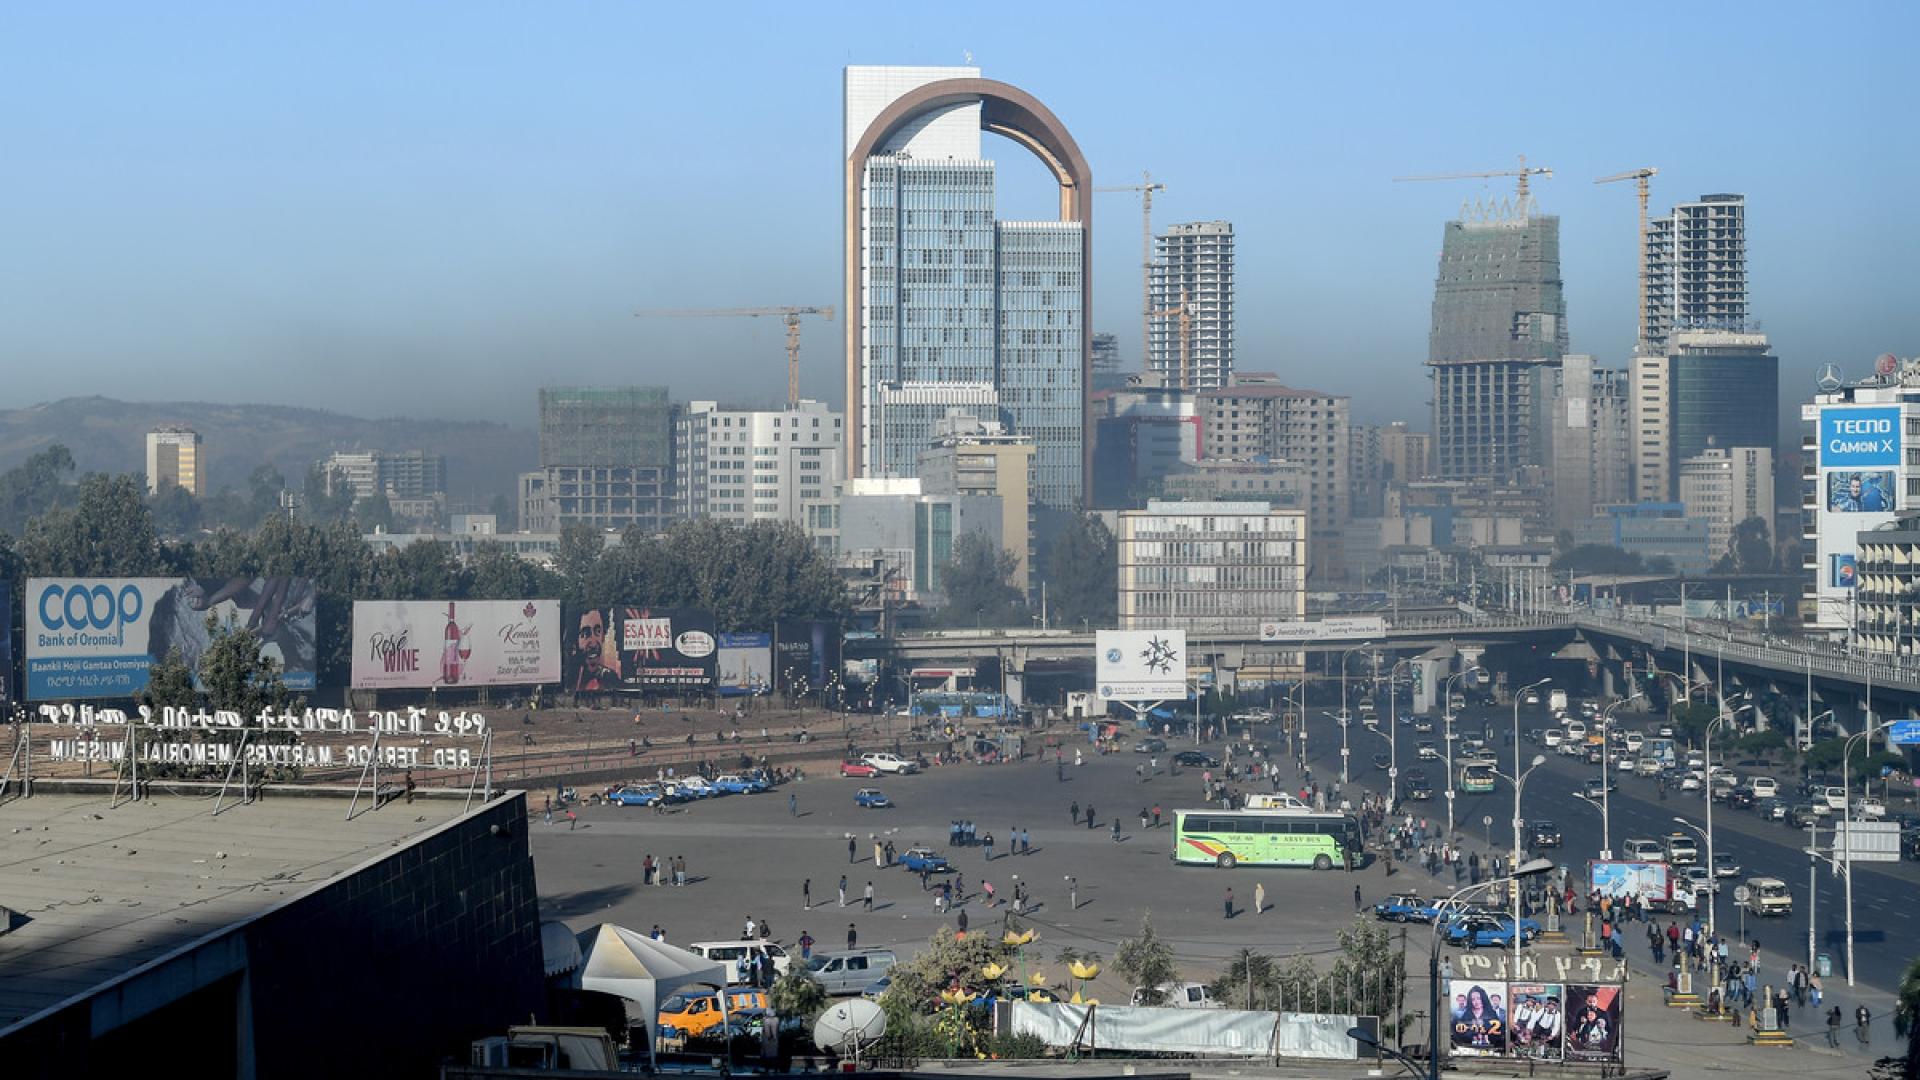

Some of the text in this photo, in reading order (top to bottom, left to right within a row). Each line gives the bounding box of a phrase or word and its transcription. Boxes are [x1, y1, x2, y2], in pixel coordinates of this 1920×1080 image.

[1833, 420, 1891, 434] TECNO
[1881, 440, 1893, 452] X
[625, 624, 670, 639] ESAYAS
[38, 633, 117, 647] Bank of Oromia
[384, 649, 419, 672] WINE
[1487, 1019, 1501, 1036] 2
